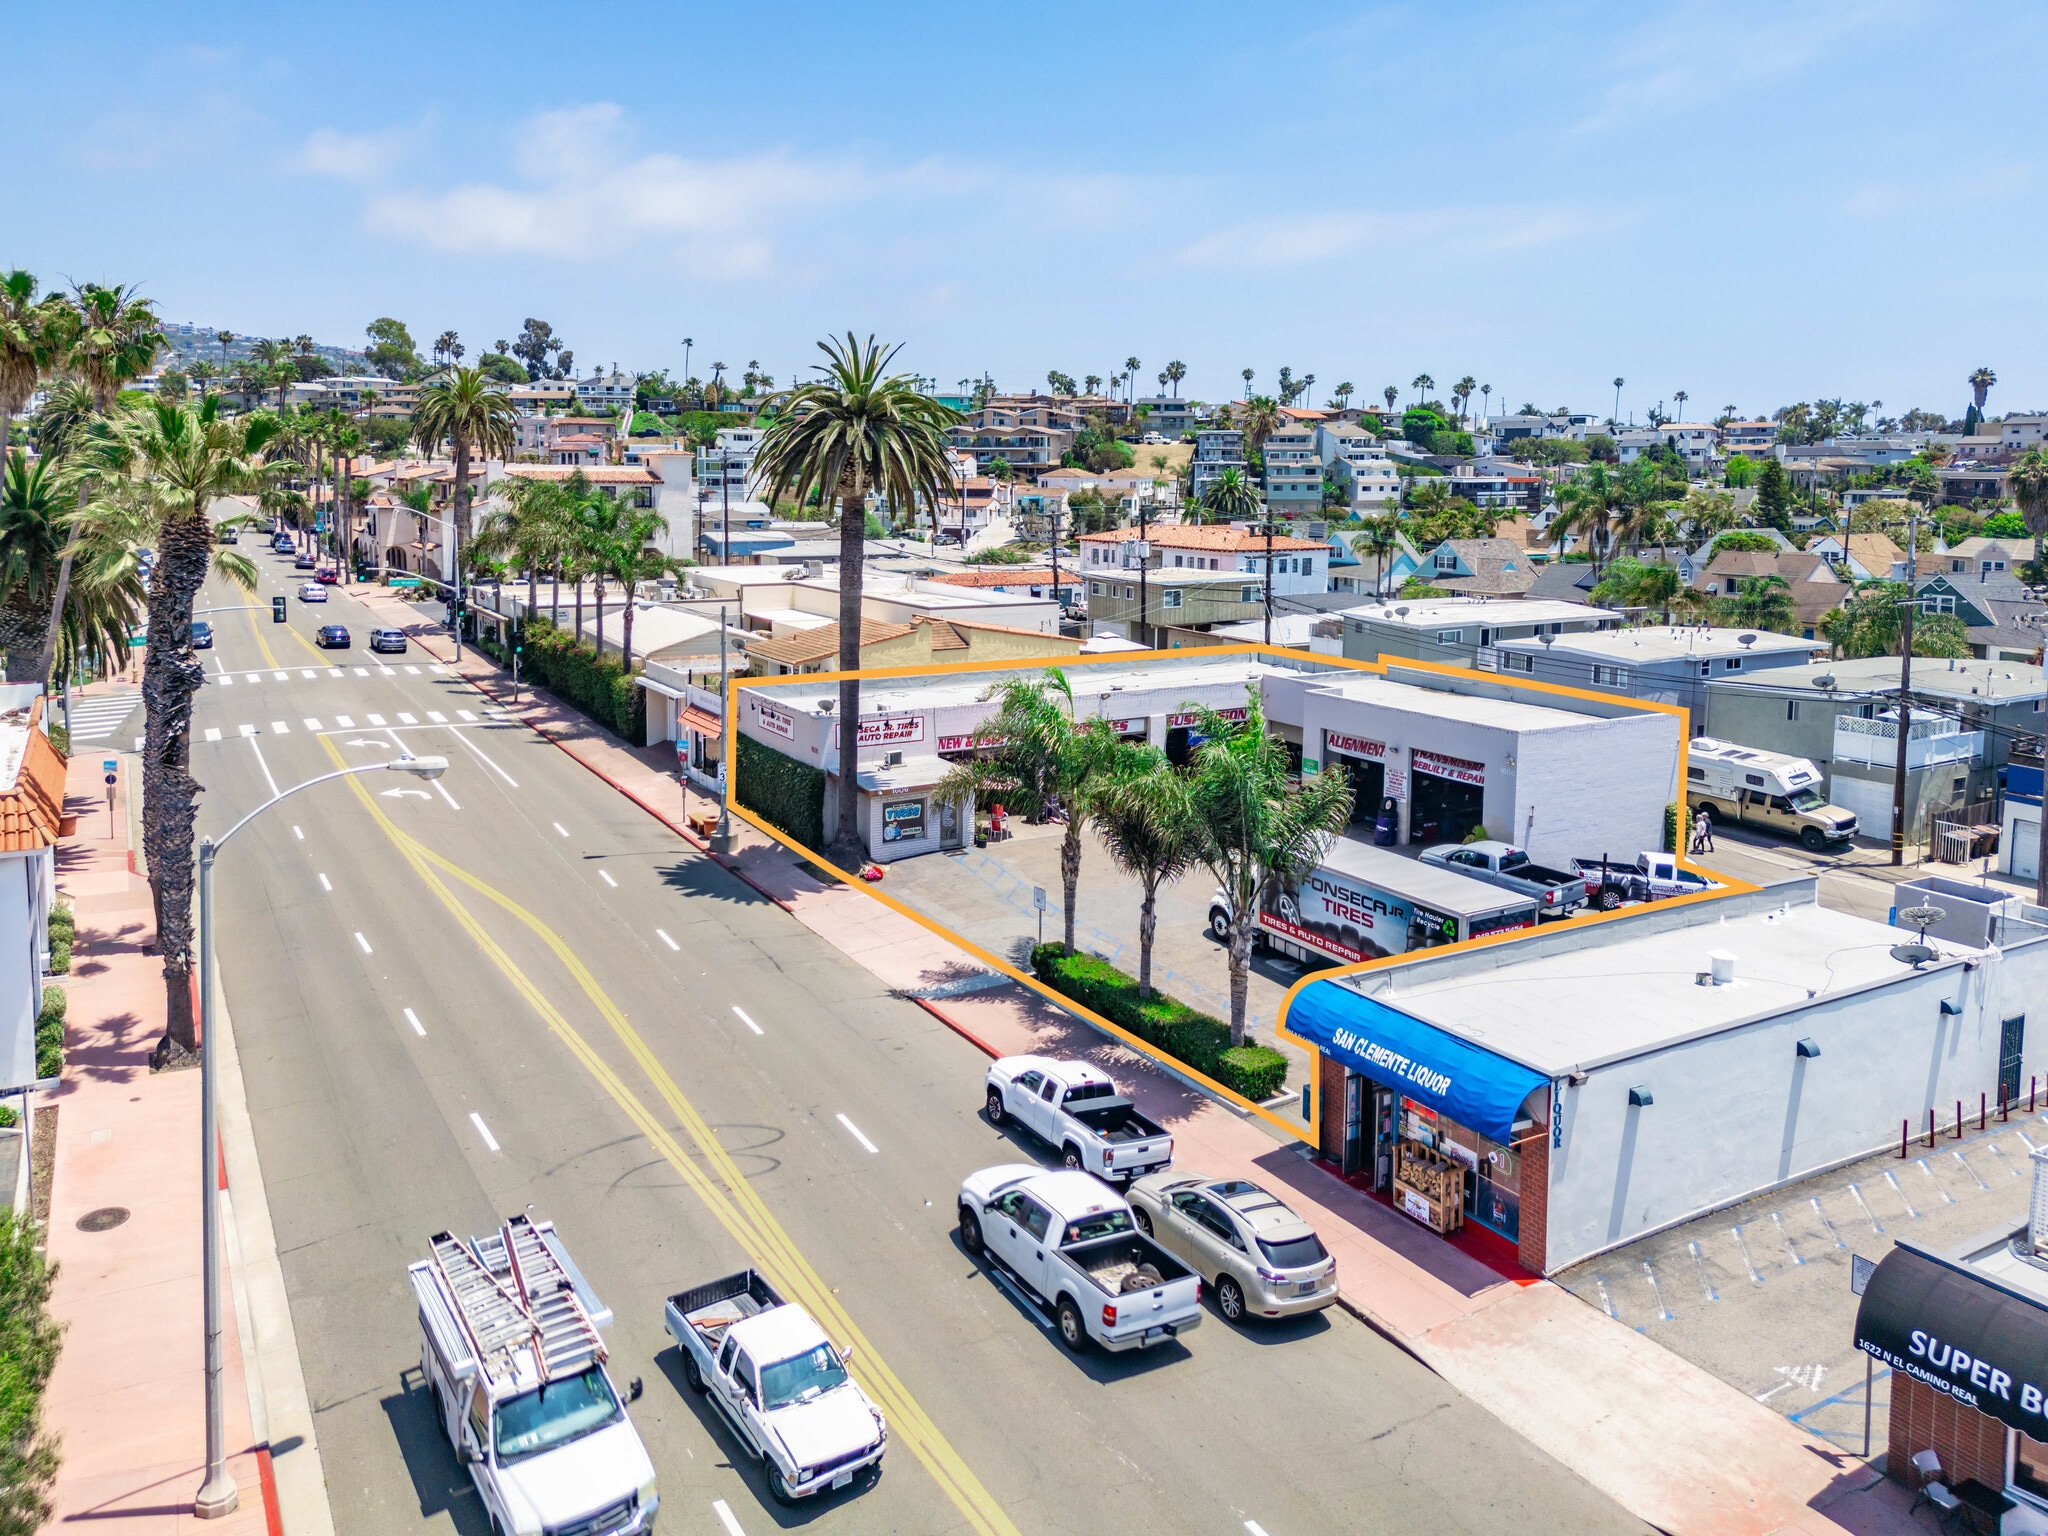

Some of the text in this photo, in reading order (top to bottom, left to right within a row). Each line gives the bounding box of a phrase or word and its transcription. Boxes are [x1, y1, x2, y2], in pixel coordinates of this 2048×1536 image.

[858, 724, 880, 734] SECA
[897, 720, 919, 730] TIRES
[858, 730, 913, 742] AUTO REPAIR
[938, 736, 963, 750] NEW
[965, 734, 973, 748] &
[1328, 733, 1386, 758] ALIGNMENT
[1412, 759, 1447, 775] REBUILT
[1447, 769, 1454, 778] &
[886, 806, 921, 820] TIRES
[1321, 896, 1375, 929] TIRES
[1388, 904, 1409, 921] JR.
[1413, 906, 1445, 924] Tire Hauler
[1416, 916, 1441, 932] Recycle
[1262, 914, 1362, 963] TIRES & AUTO REPAIR
[1319, 1044, 1332, 1056] REAL
[1331, 1026, 1358, 1052] SAN
[1353, 1036, 1412, 1077] CLEMENTE
[1406, 1060, 1452, 1097] LIQUOR
[1552, 1080, 1563, 1149] LIQUOR
[1858, 1338, 1980, 1406] 1622 N EL CAMINO REAL
[1907, 1328, 2048, 1424] SUPER B
